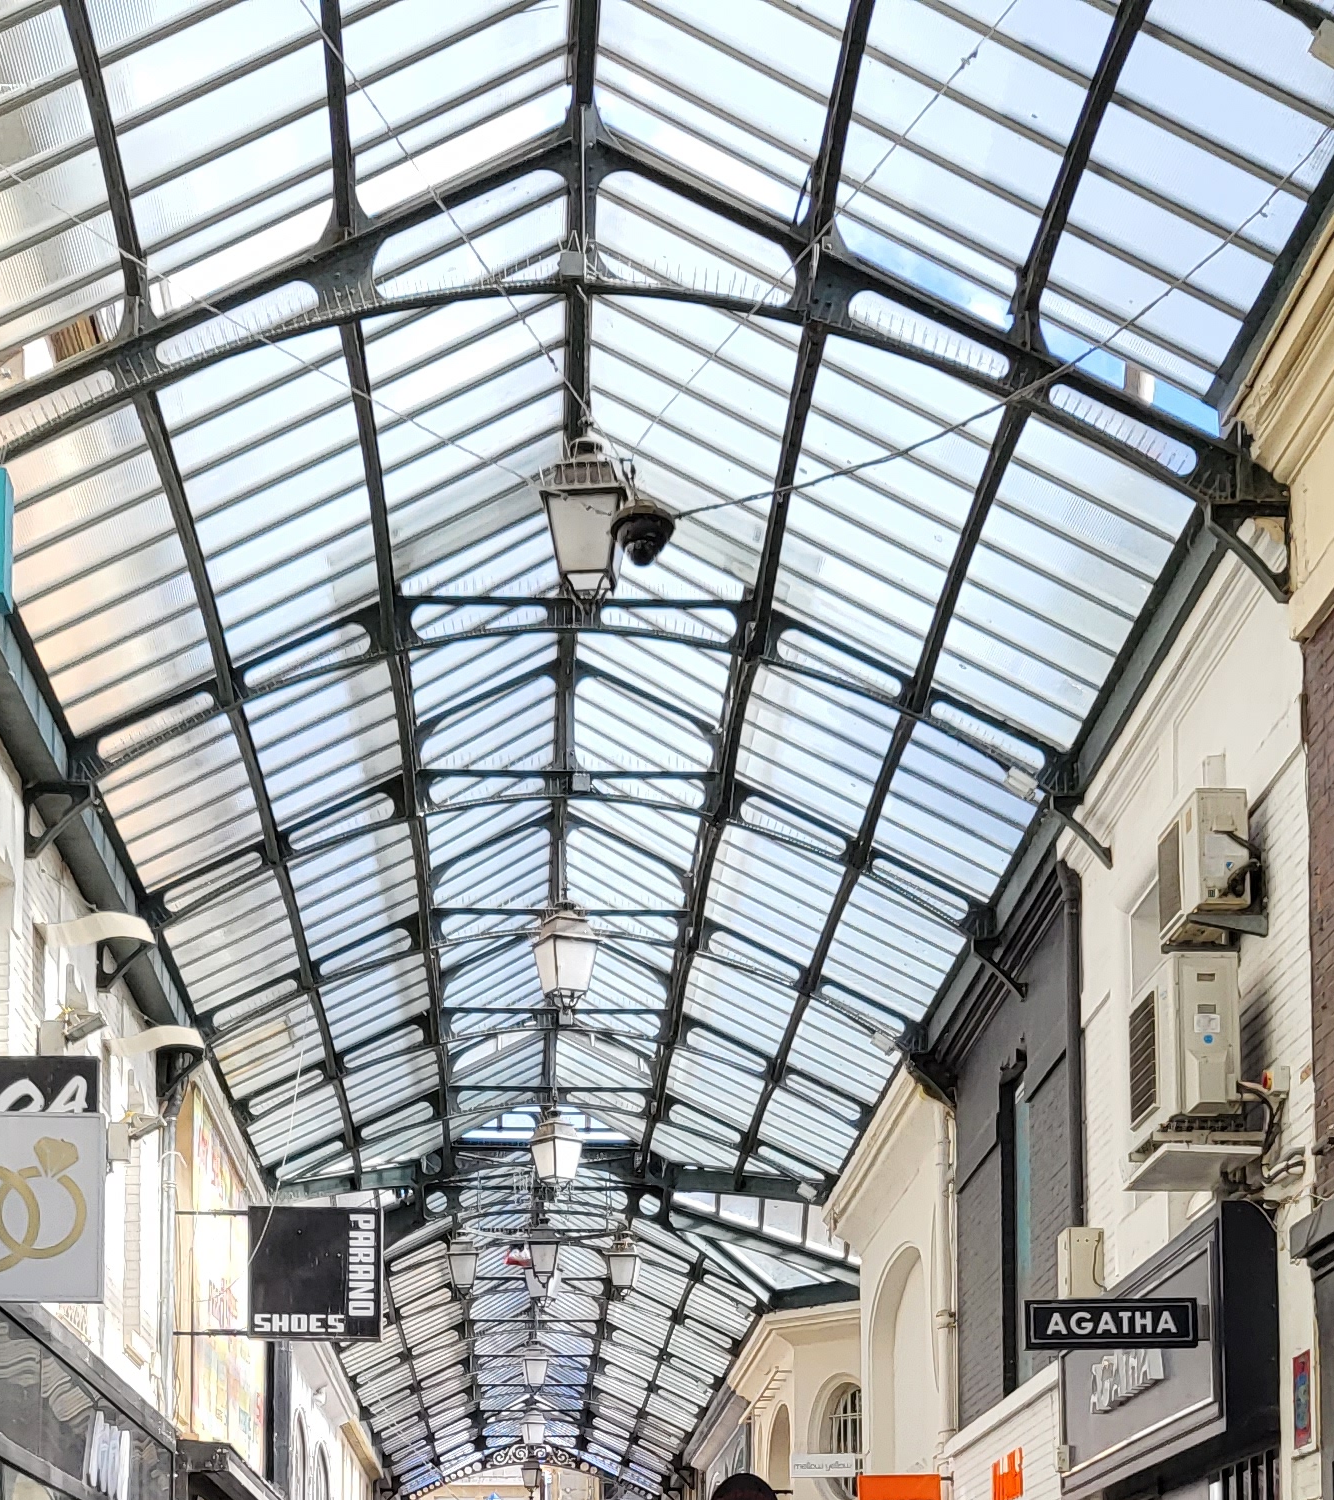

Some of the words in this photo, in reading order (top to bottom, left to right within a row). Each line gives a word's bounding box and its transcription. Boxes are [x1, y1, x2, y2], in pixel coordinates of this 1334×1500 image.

[349, 1213, 376, 1317] PARANO
[254, 1314, 345, 1333] SHOES
[1046, 1311, 1178, 1335] AGATHA
